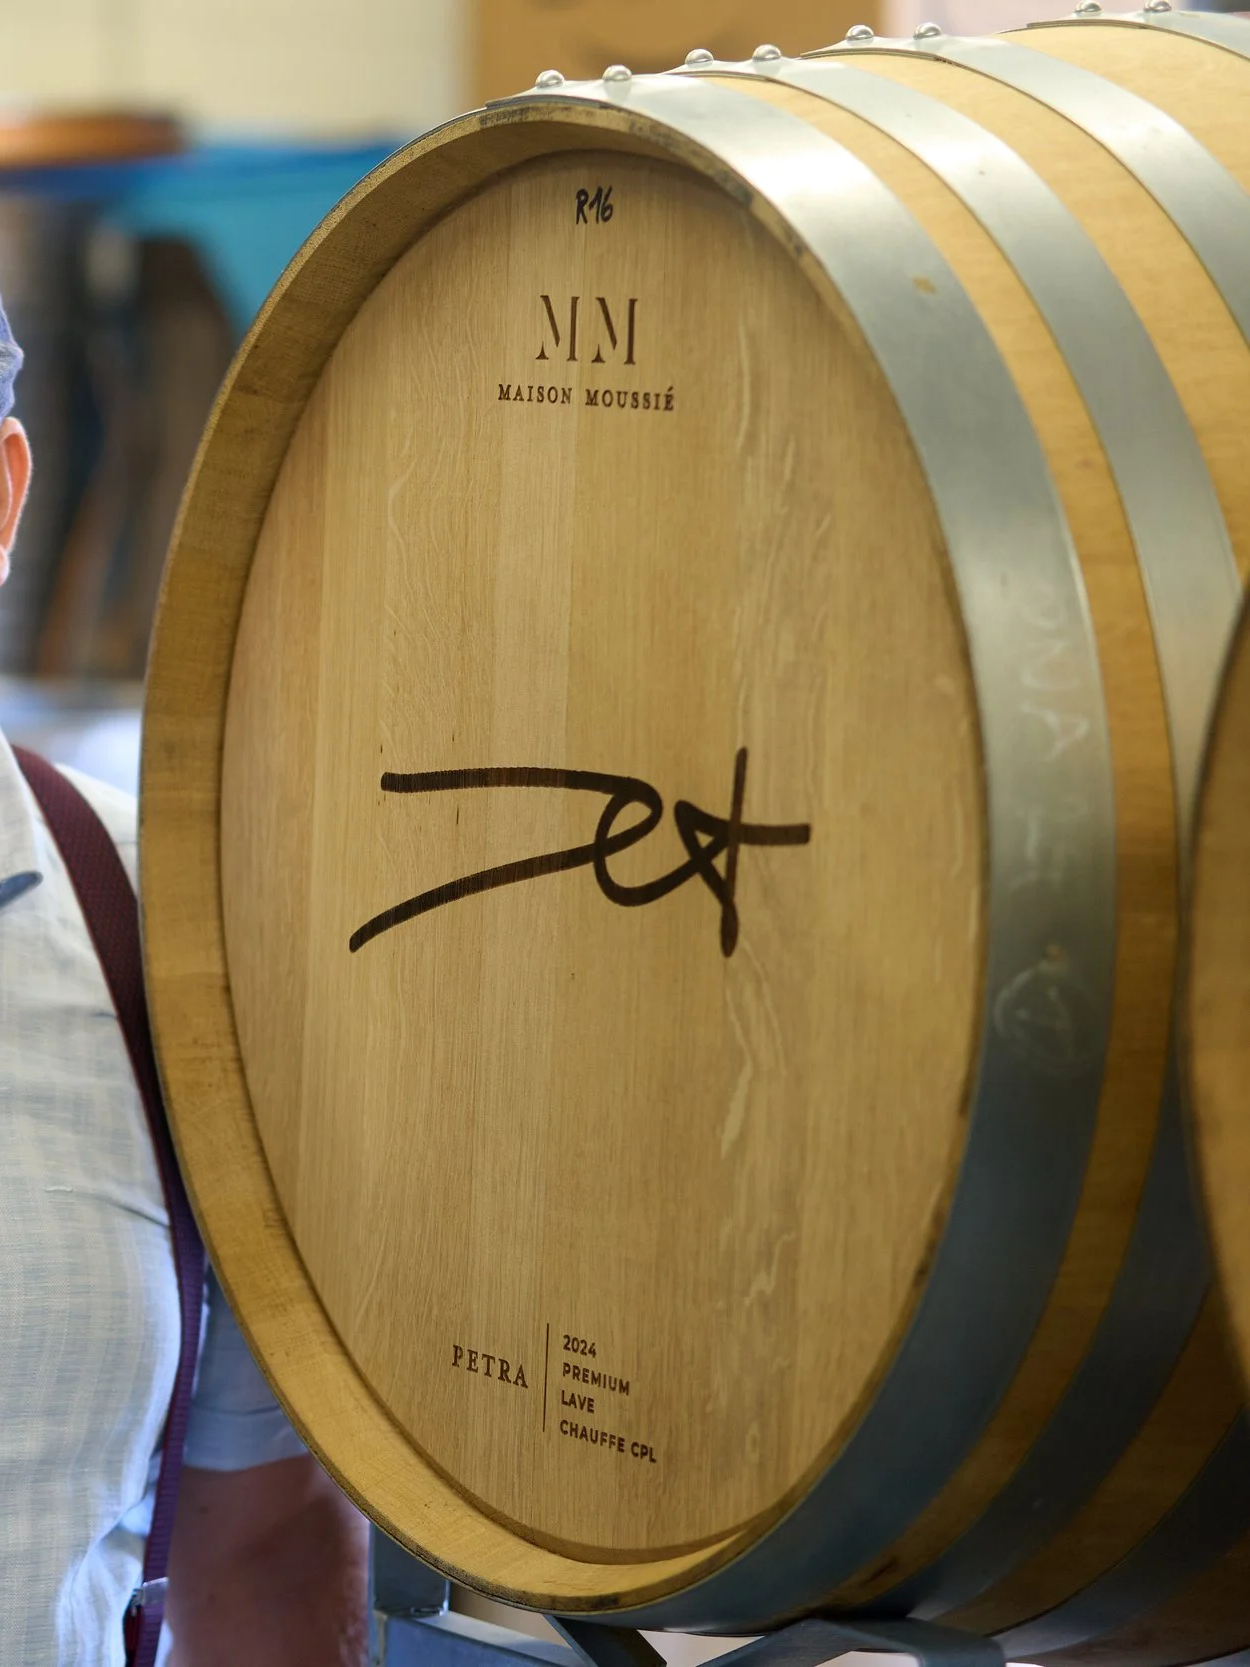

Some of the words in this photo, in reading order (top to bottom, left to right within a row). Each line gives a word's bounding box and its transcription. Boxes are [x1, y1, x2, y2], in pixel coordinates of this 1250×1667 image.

[575, 185, 614, 225] R16
[535, 294, 638, 366] MM
[498, 383, 573, 405] MAISON
[585, 385, 675, 412] MOUSSIÉ
[562, 1334, 597, 1359] 2024
[451, 1344, 529, 1389] PETRA
[561, 1361, 631, 1397] PREMIUM
[560, 1389, 595, 1414] LAVE
[559, 1419, 626, 1454] CHAUFFE
[630, 1441, 657, 1464] CPL
